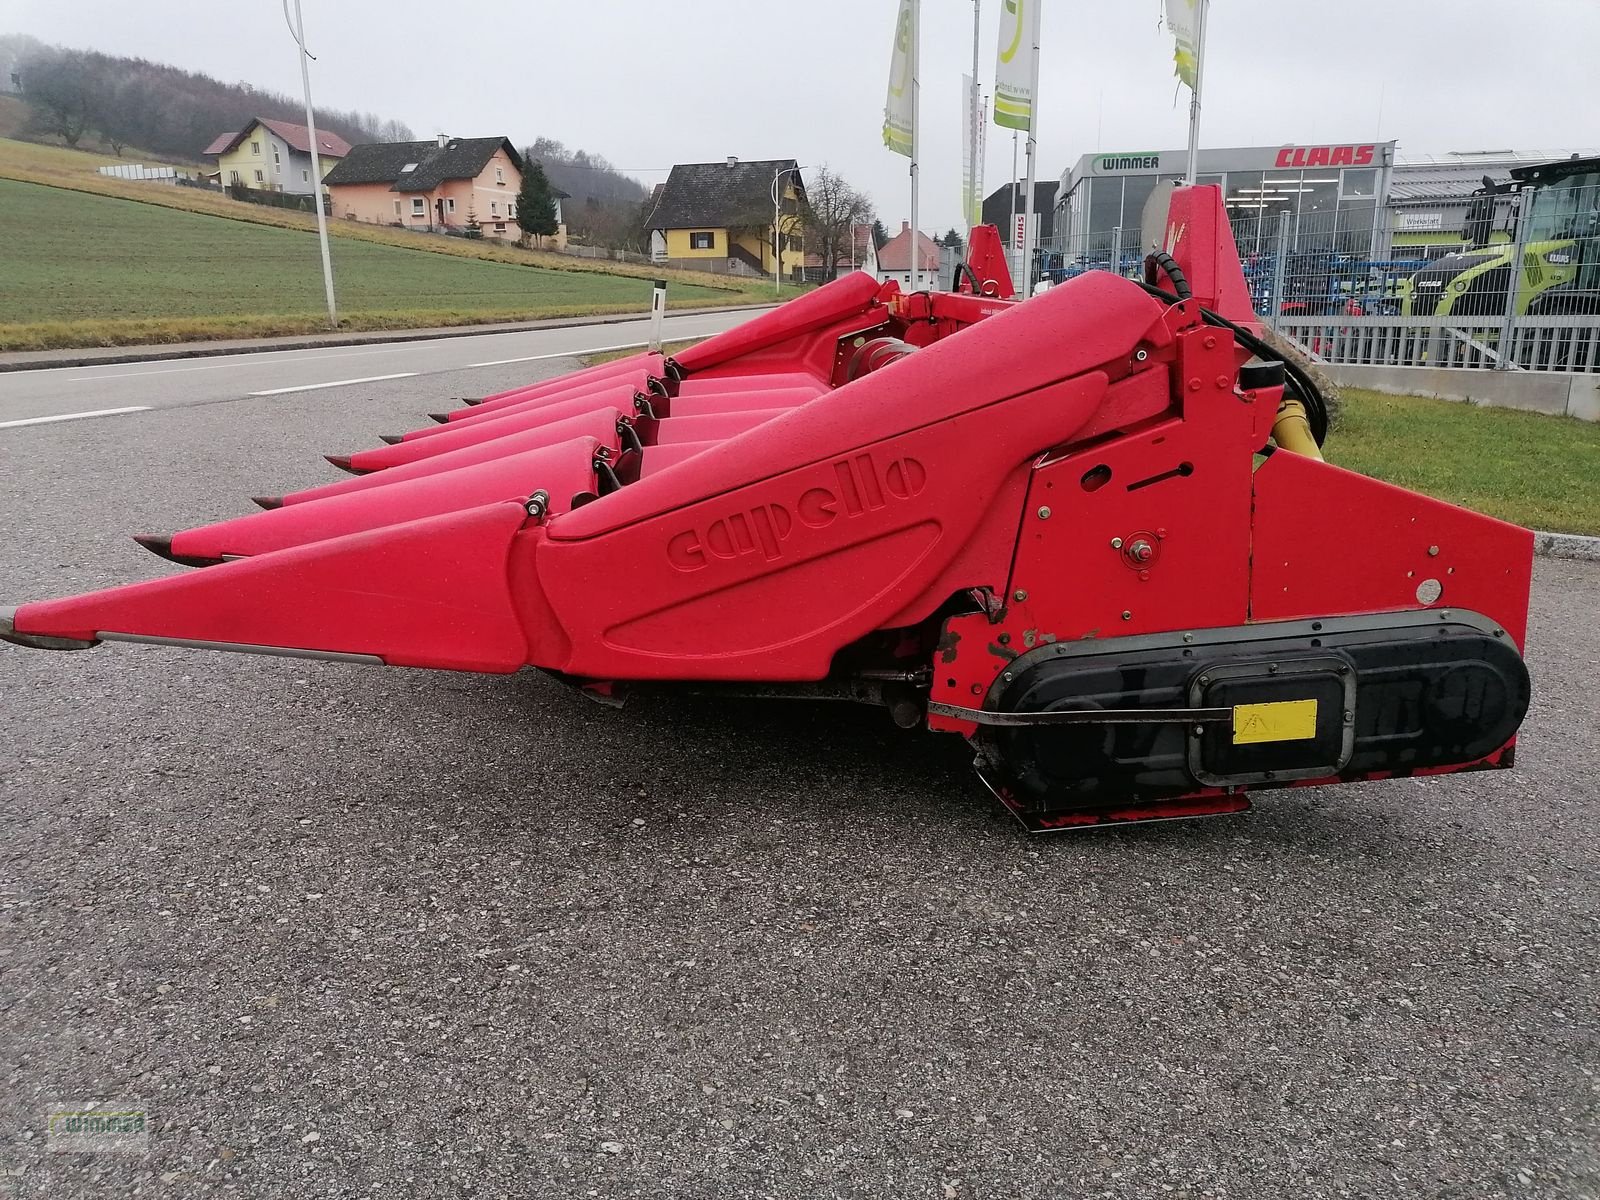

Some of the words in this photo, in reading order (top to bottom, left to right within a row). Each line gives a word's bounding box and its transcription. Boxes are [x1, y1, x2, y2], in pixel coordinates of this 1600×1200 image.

[1103, 156, 1159, 170] WIMMER
[1275, 145, 1375, 168] CLAAS
[1016, 216, 1025, 250] CLAAS
